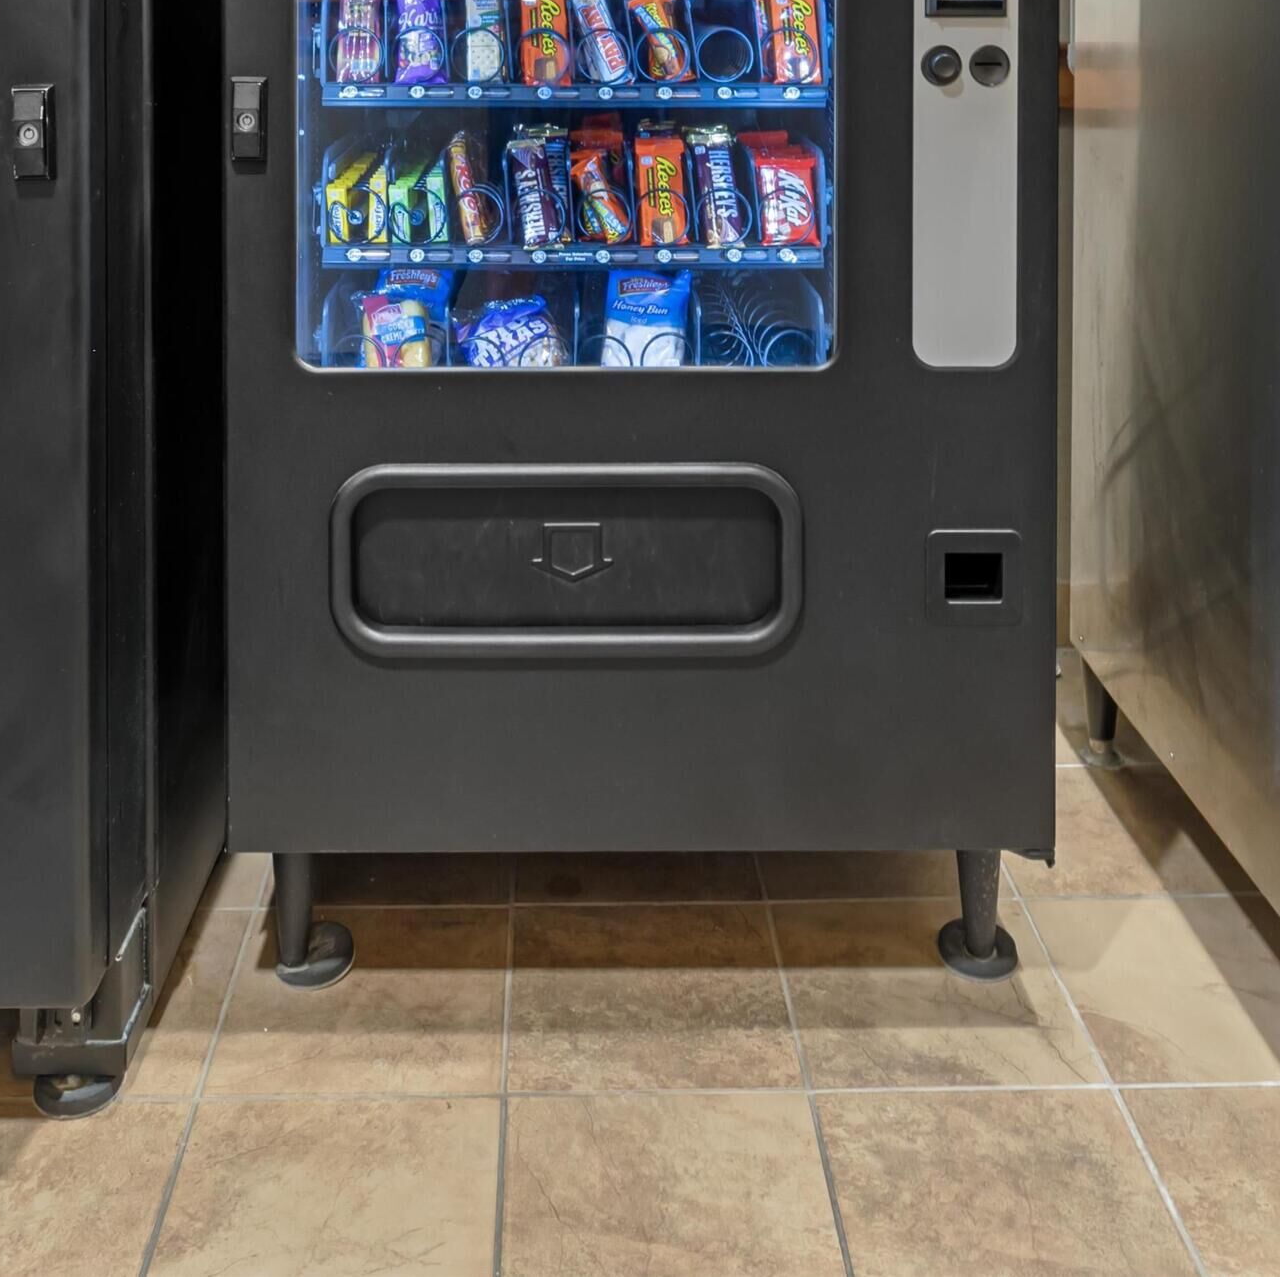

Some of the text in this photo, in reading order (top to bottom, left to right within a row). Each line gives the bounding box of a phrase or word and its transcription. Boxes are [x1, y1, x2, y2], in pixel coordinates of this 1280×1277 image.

[656, 155, 677, 217] Reese's
[708, 149, 738, 218] HERSHEY'S
[516, 169, 545, 239] HERSHEY'S
[391, 270, 438, 283] Freshley's
[623, 279, 670, 291] Freshley's
[612, 300, 669, 315] Honey Bun
[630, 315, 648, 323] Iced
